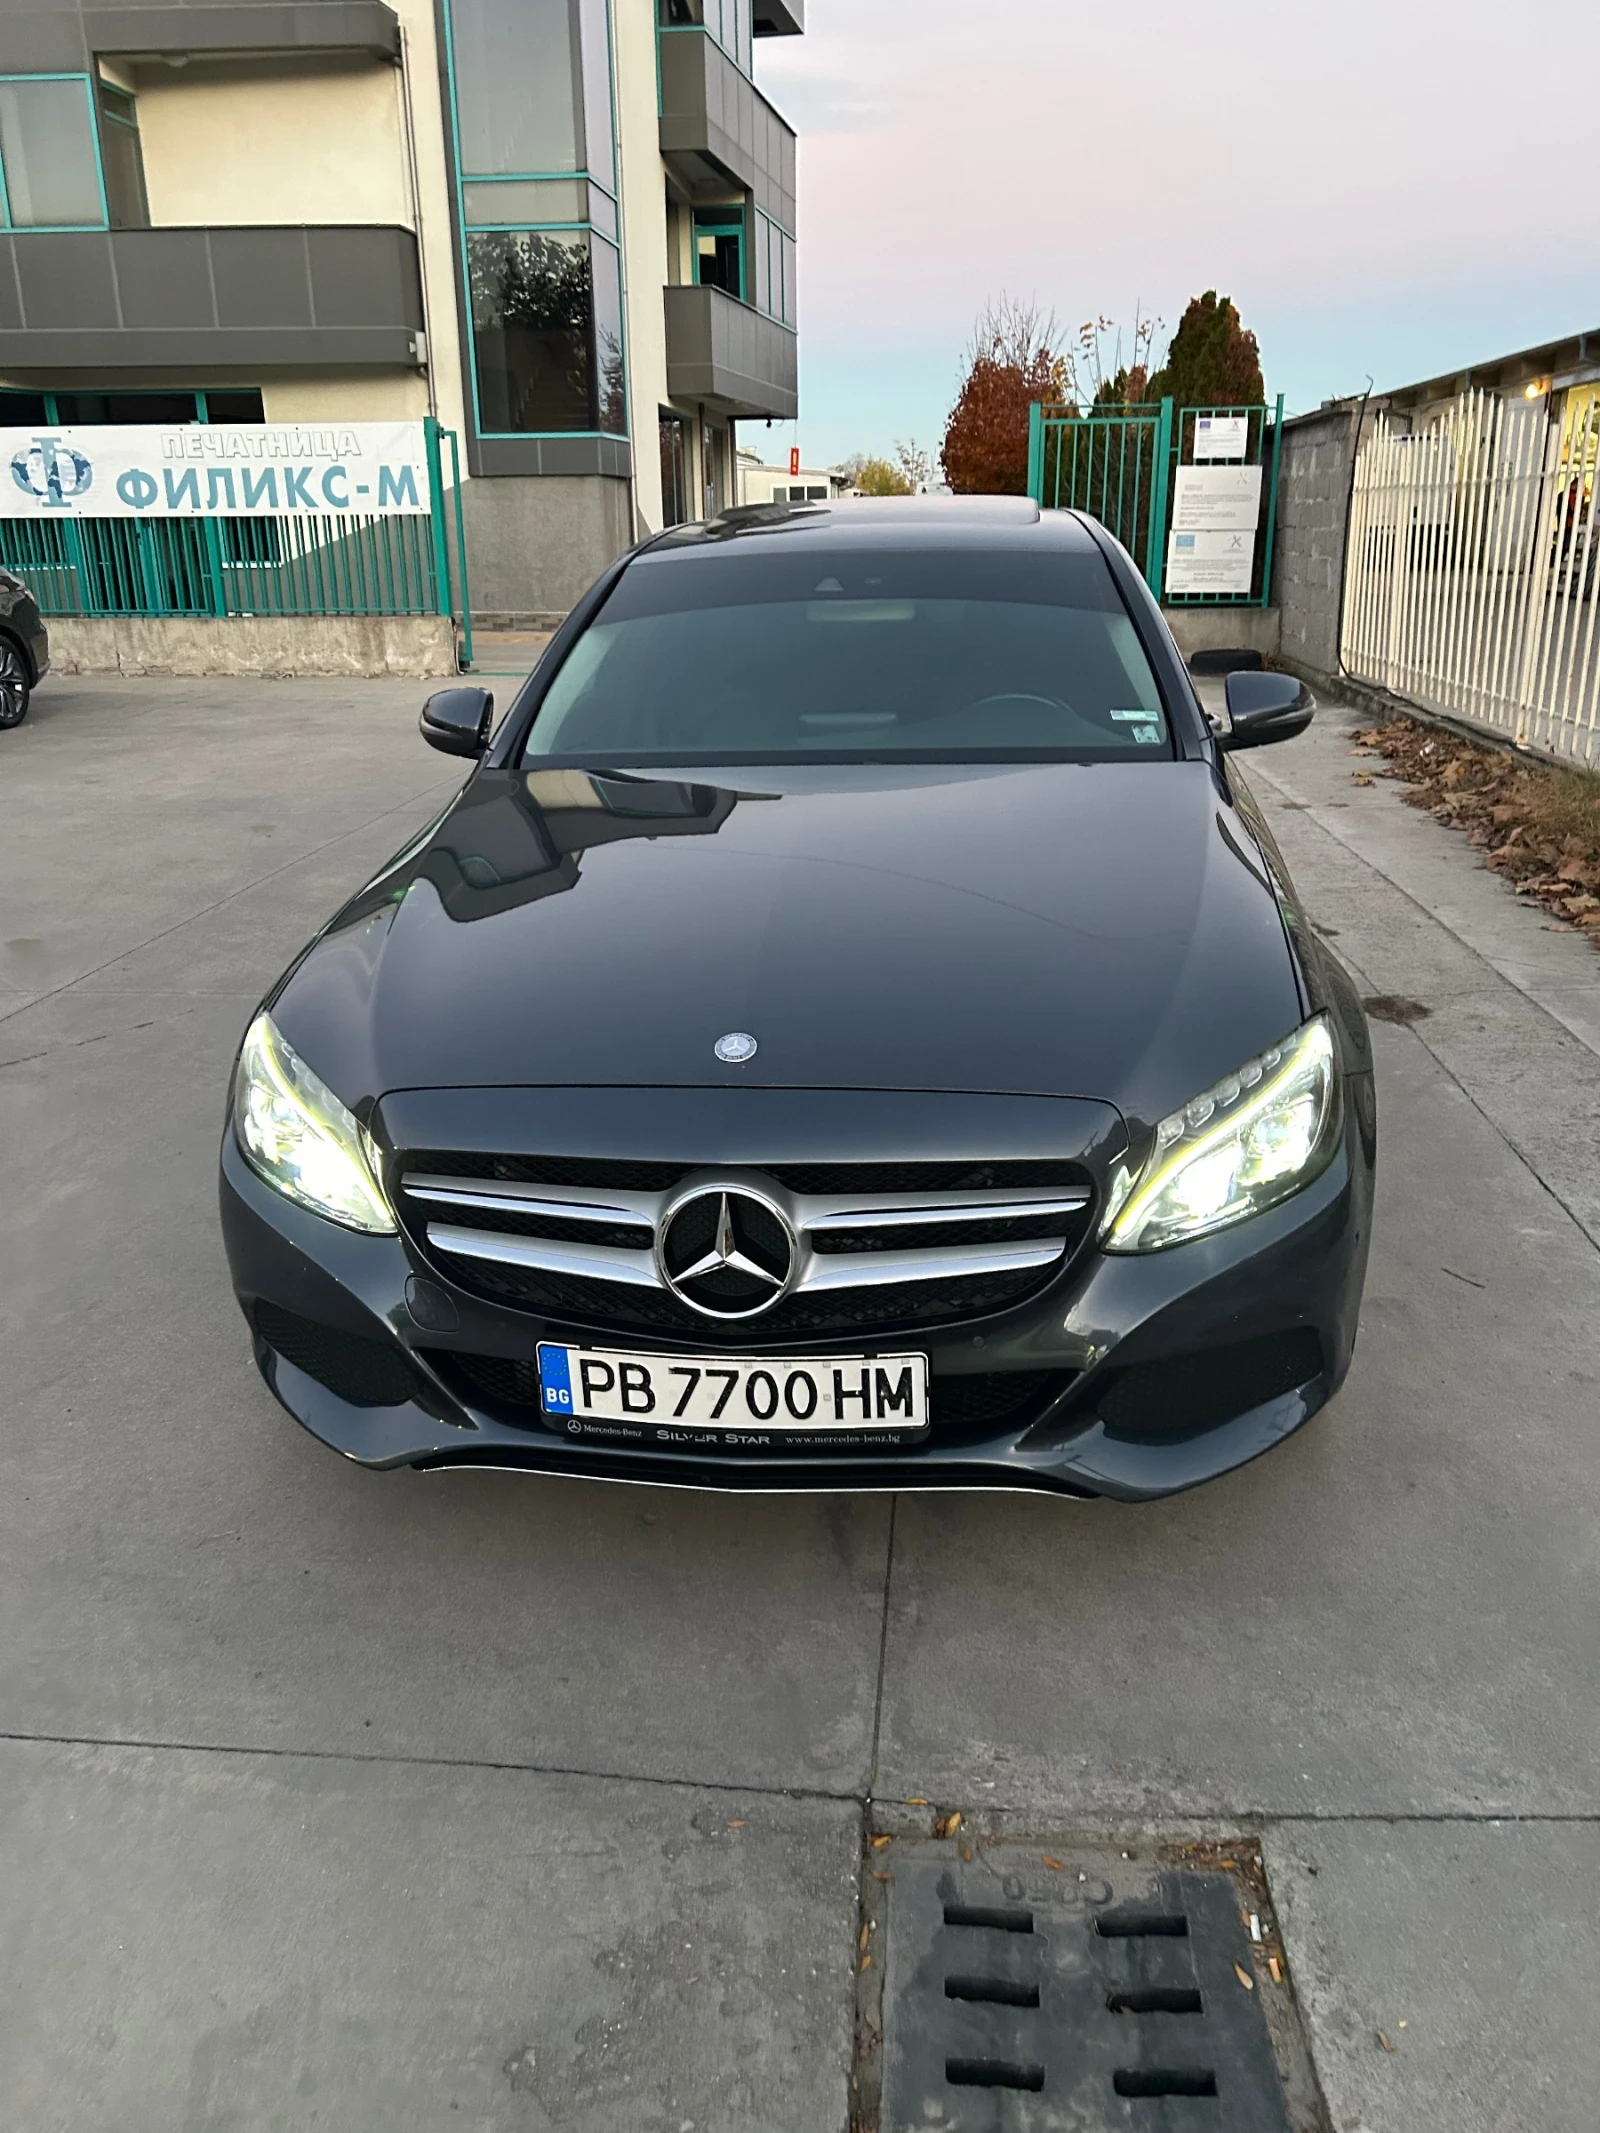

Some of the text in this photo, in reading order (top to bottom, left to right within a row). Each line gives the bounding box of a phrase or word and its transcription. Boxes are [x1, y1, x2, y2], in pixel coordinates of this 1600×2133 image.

[160, 429, 362, 462] ПЕЧАТНИЦА
[116, 465, 420, 510] ФИЛИКС-М
[546, 1387, 570, 1405] BG
[579, 1358, 914, 1420] PB 7700 HM
[583, 1424, 642, 1437] Mercedes-Benz
[725, 1432, 771, 1444] STAR
[785, 1433, 901, 1444] www.mercedes-benz.bg
